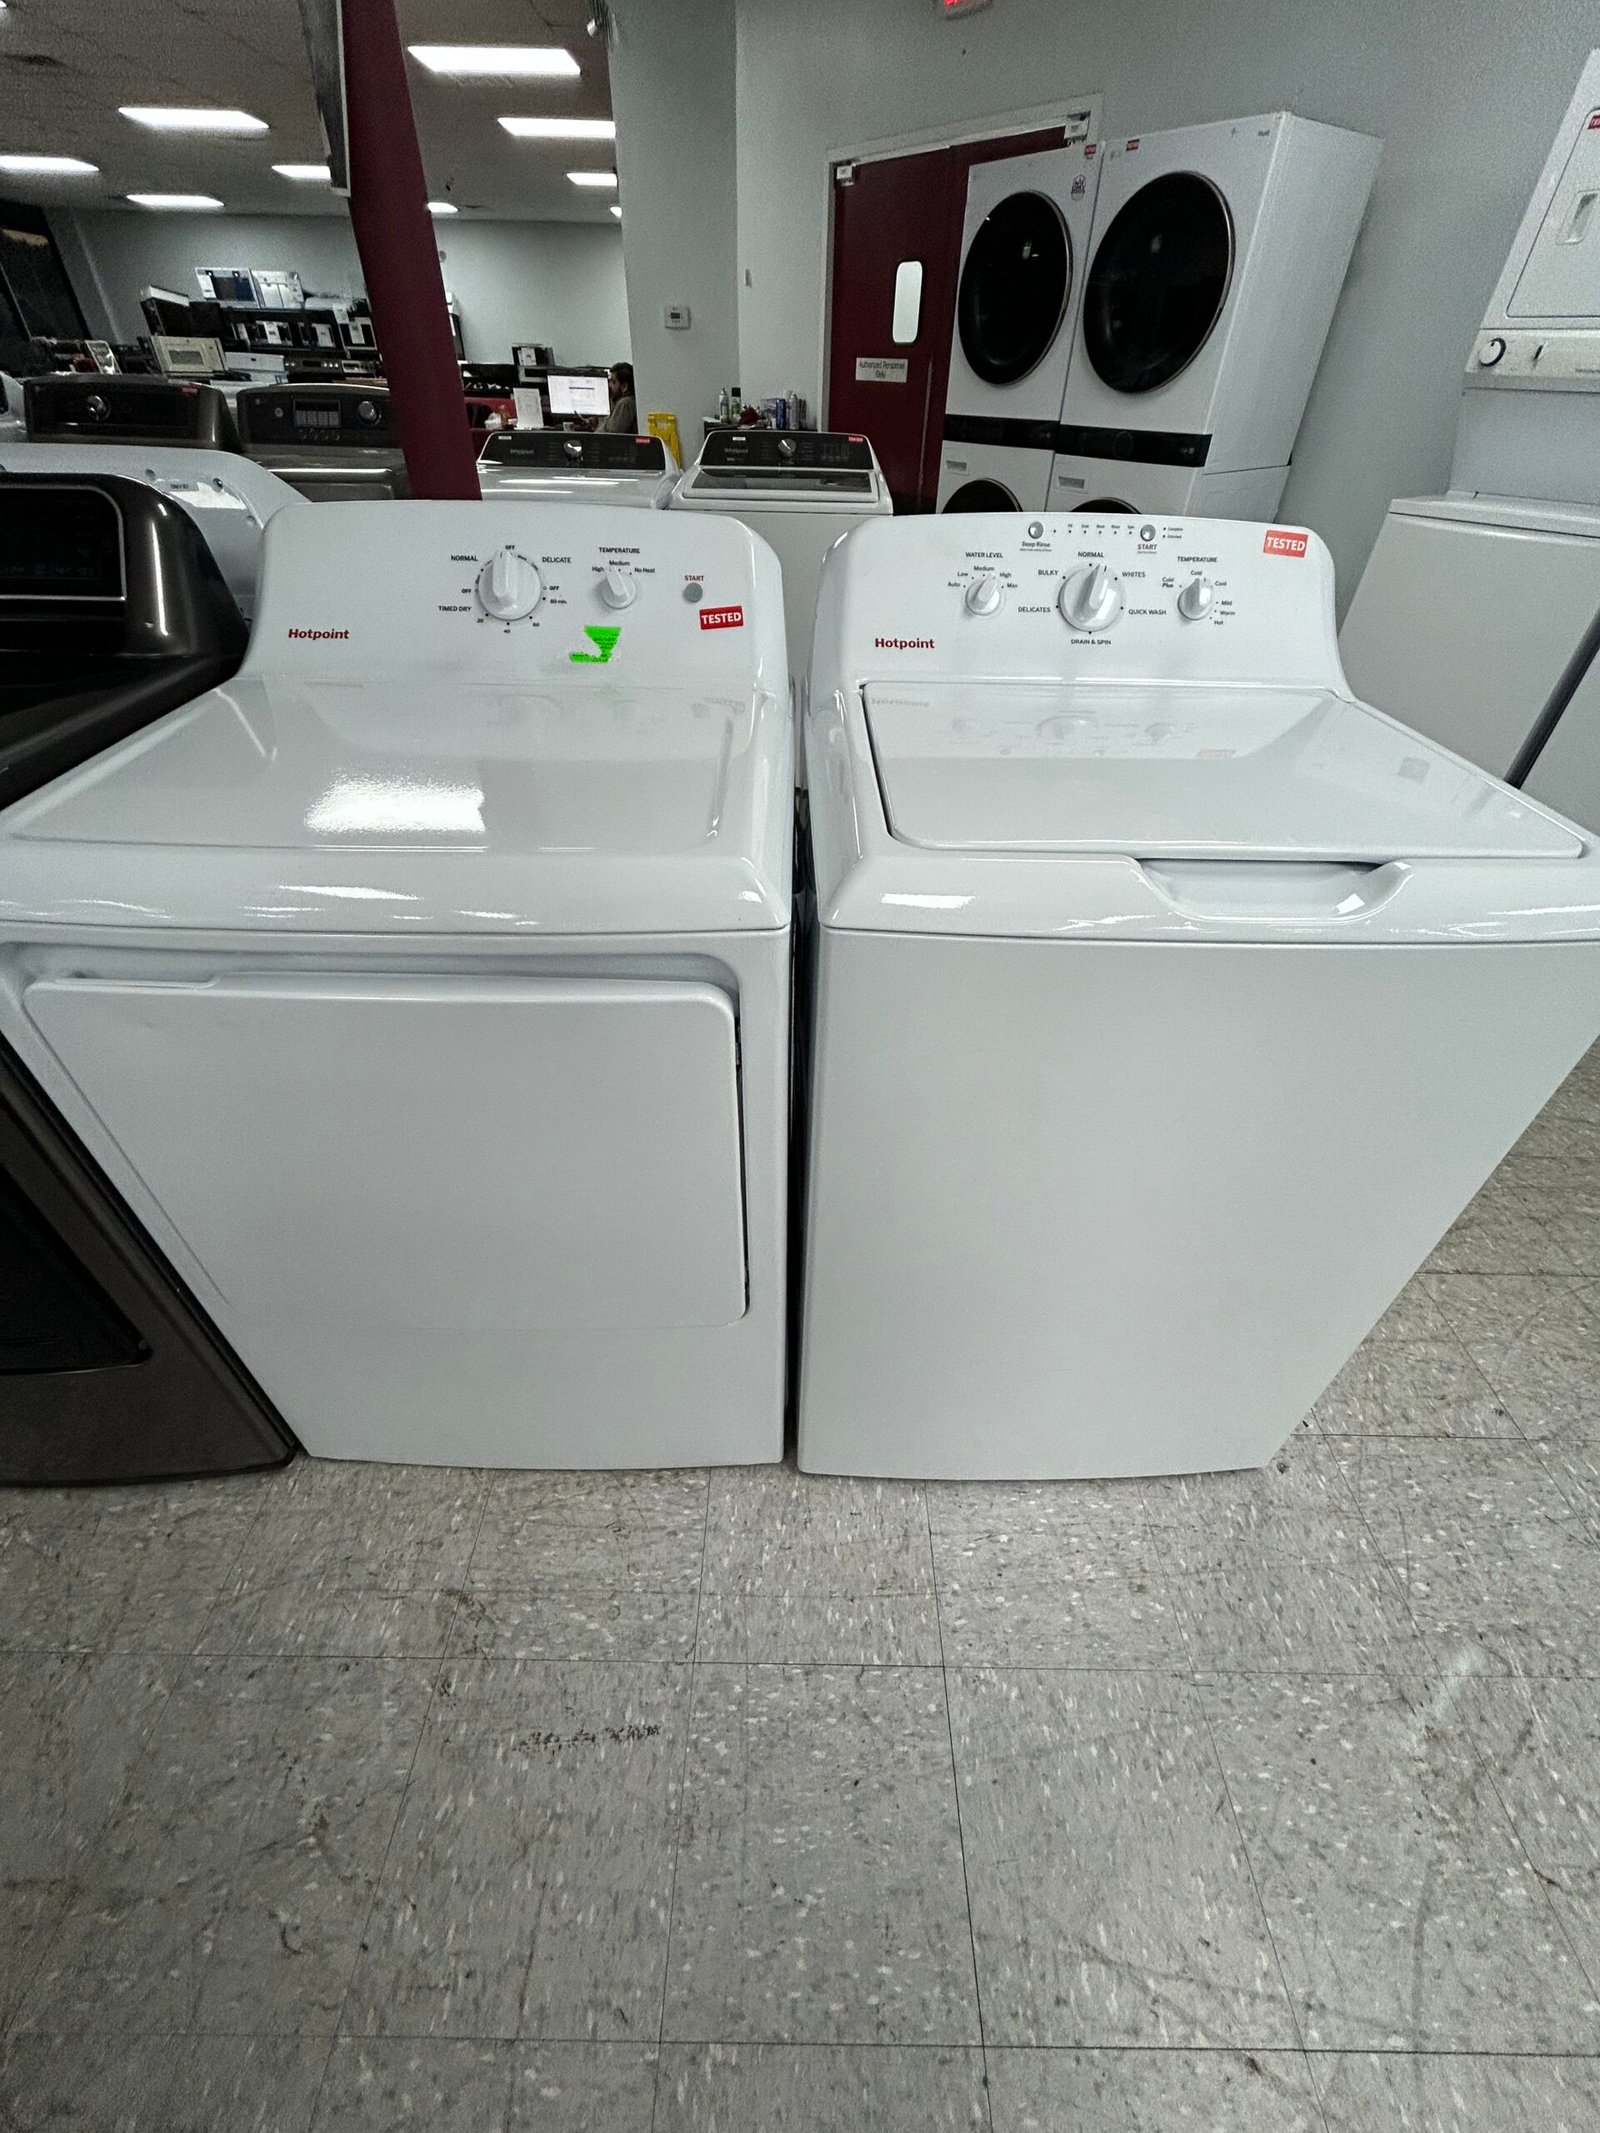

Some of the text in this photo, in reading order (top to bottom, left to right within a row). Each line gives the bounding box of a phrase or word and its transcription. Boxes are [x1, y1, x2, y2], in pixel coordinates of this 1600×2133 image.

[1266, 537, 1306, 552] TESTED
[701, 612, 742, 625] TESTED
[288, 628, 350, 640] Hotpoint
[875, 638, 935, 650] Hotpoint
